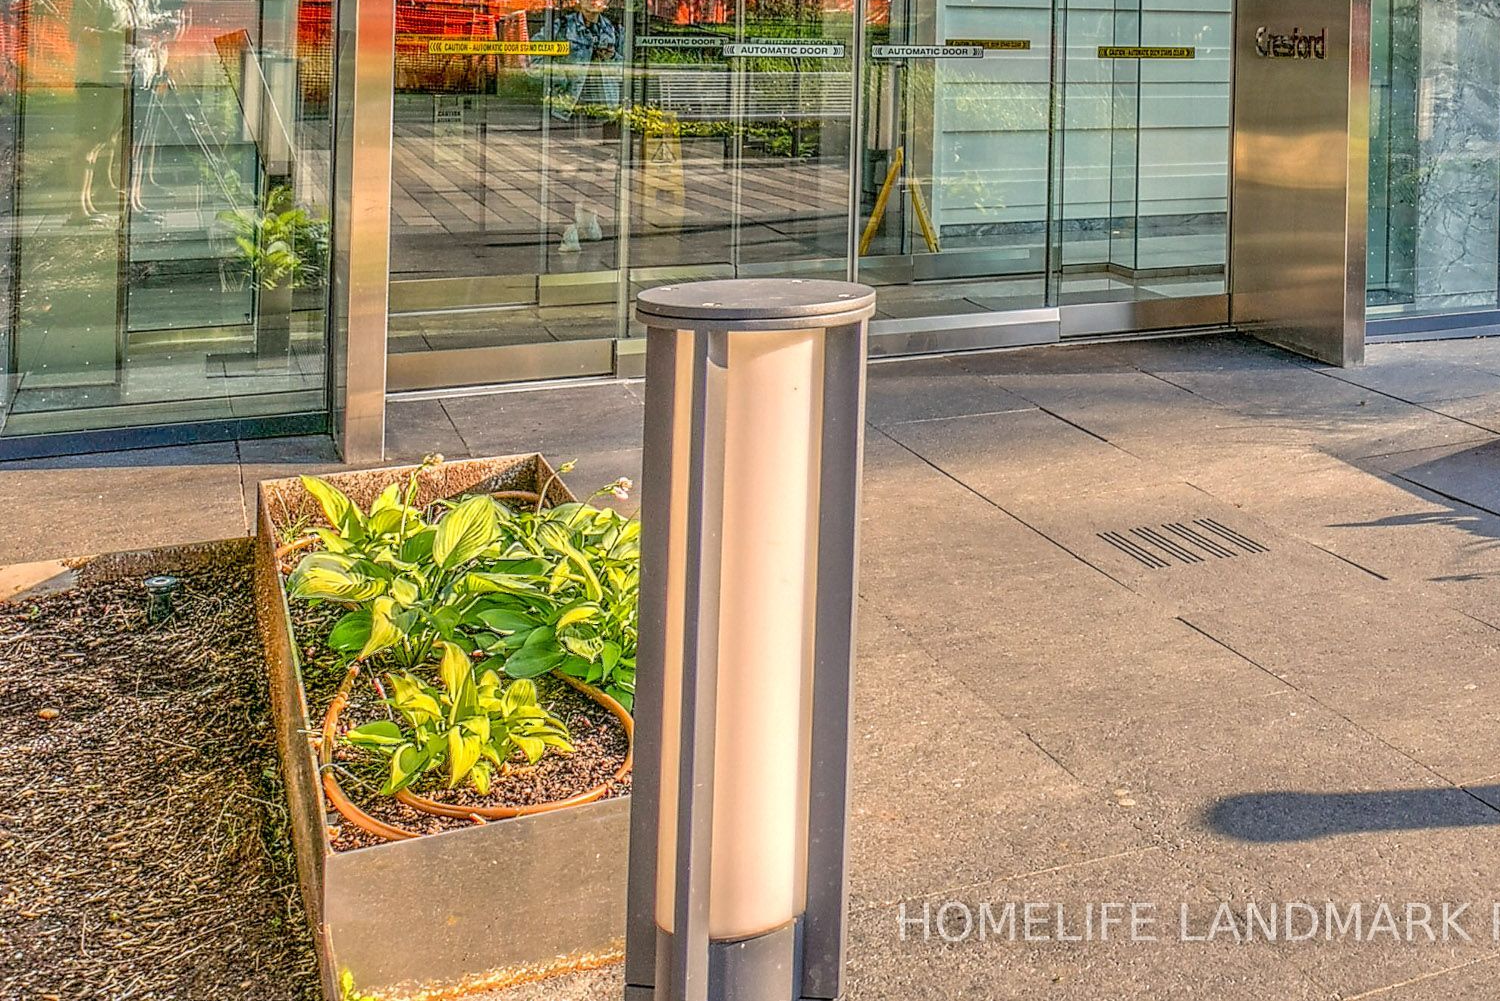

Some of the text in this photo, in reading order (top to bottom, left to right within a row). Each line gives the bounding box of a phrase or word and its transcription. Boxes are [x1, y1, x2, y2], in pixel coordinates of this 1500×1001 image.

[641, 38, 716, 46] AUTOMATIC DOOR
[1256, 26, 1328, 59] Cresford
[444, 42, 468, 51] CAUTION
[473, 42, 503, 51] AUTOMATIC
[504, 42, 519, 51] DOOR
[538, 43, 555, 52] CLEAR
[740, 46, 828, 55] AUTOMATIC DOOR
[887, 48, 969, 56] AUTOMATIC DOOR
